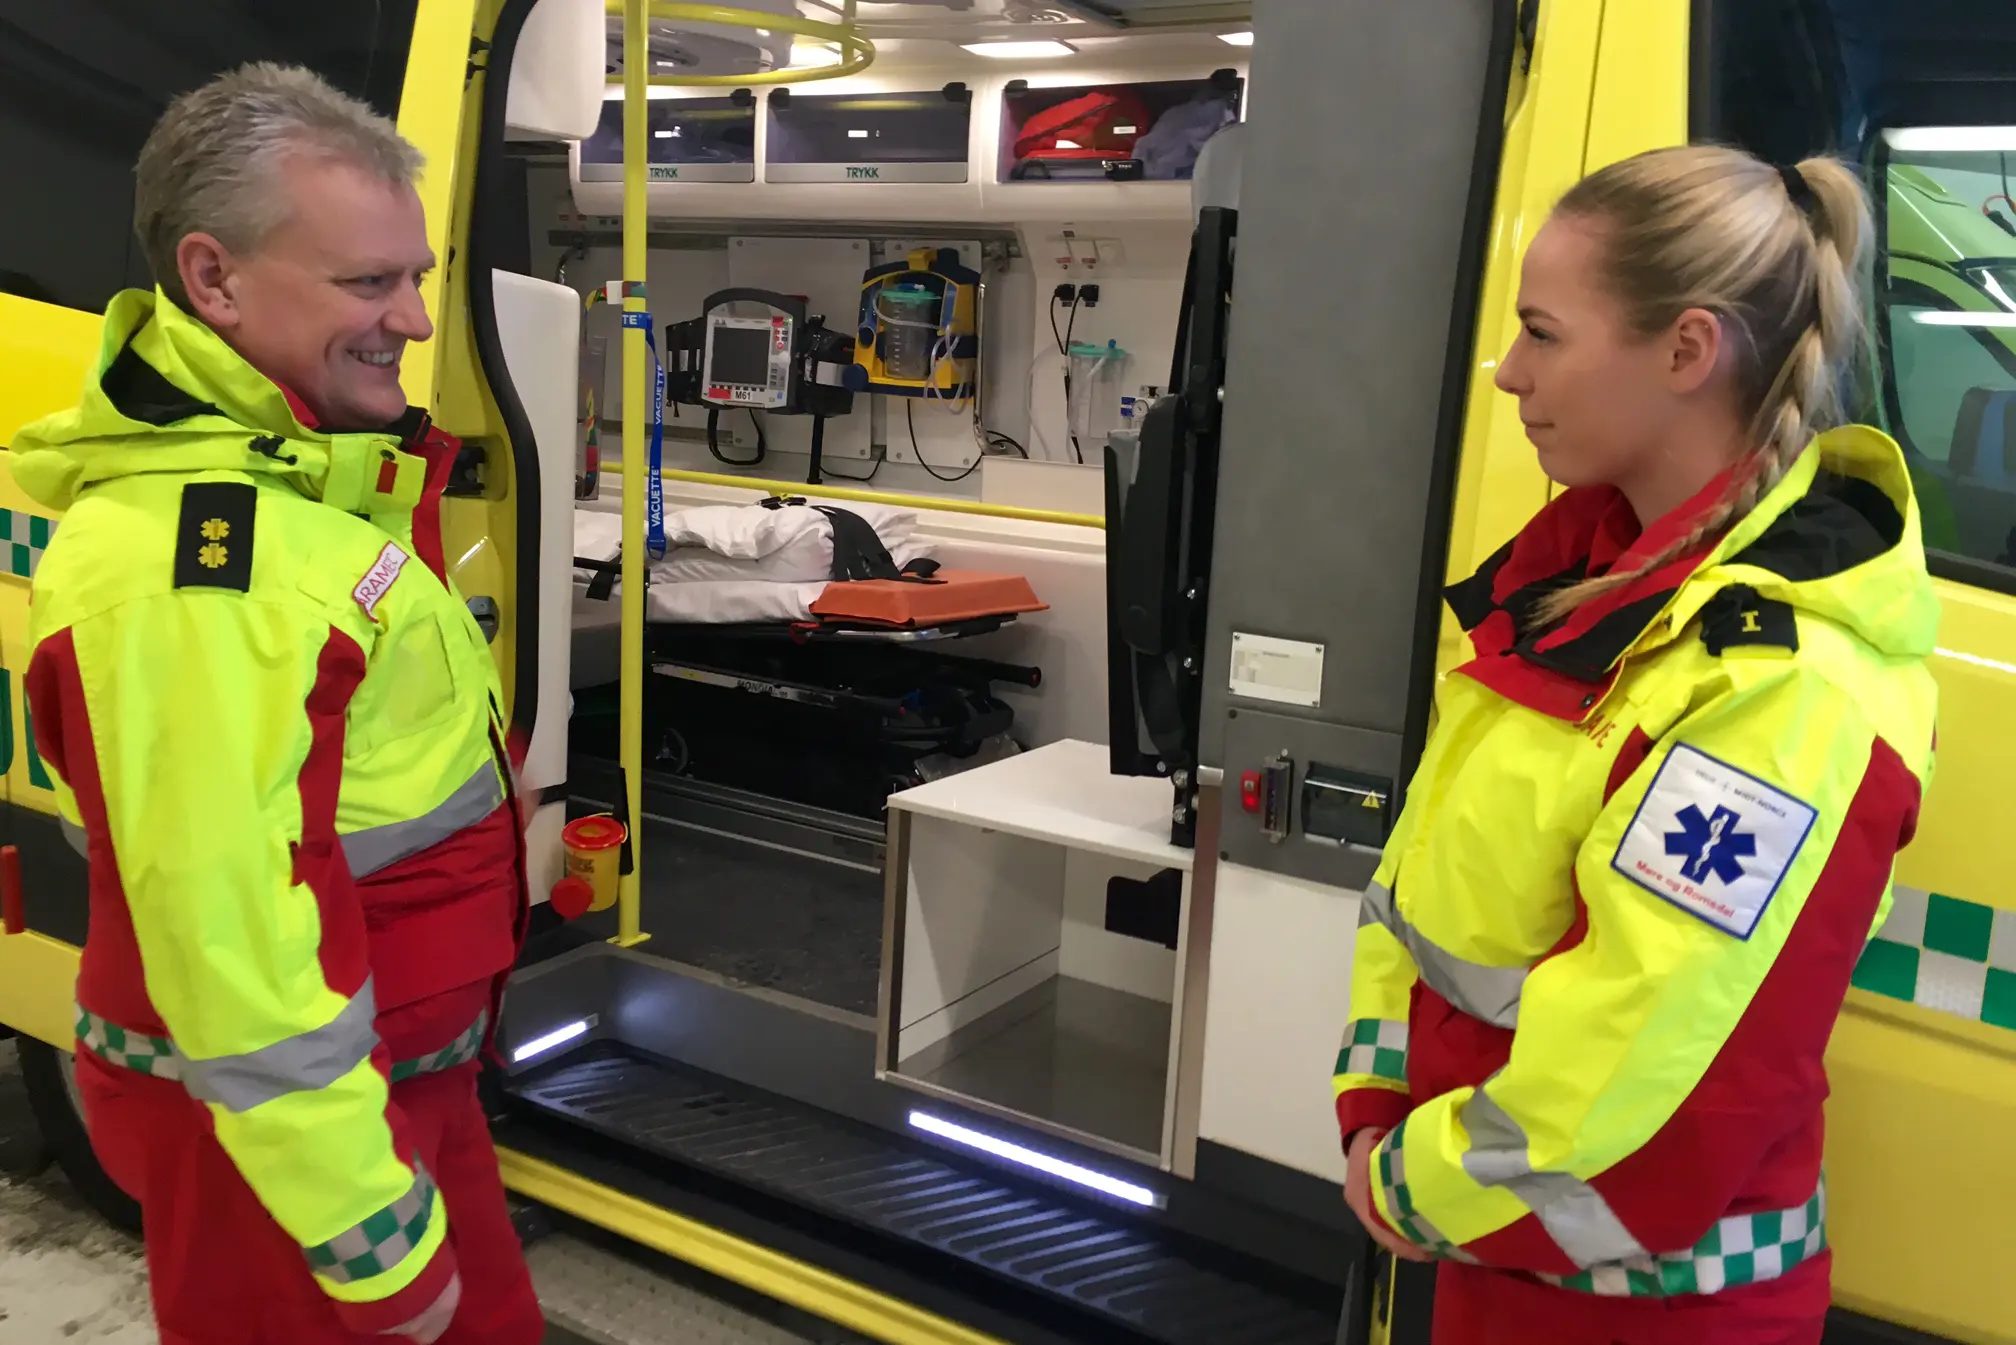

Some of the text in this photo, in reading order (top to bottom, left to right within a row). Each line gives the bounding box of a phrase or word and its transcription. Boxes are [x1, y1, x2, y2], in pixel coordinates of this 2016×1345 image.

[650, 168, 678, 178] TRYKK
[846, 167, 878, 178] TRYKK
[735, 391, 751, 400] M61
[651, 468, 660, 528] VACUETTE
